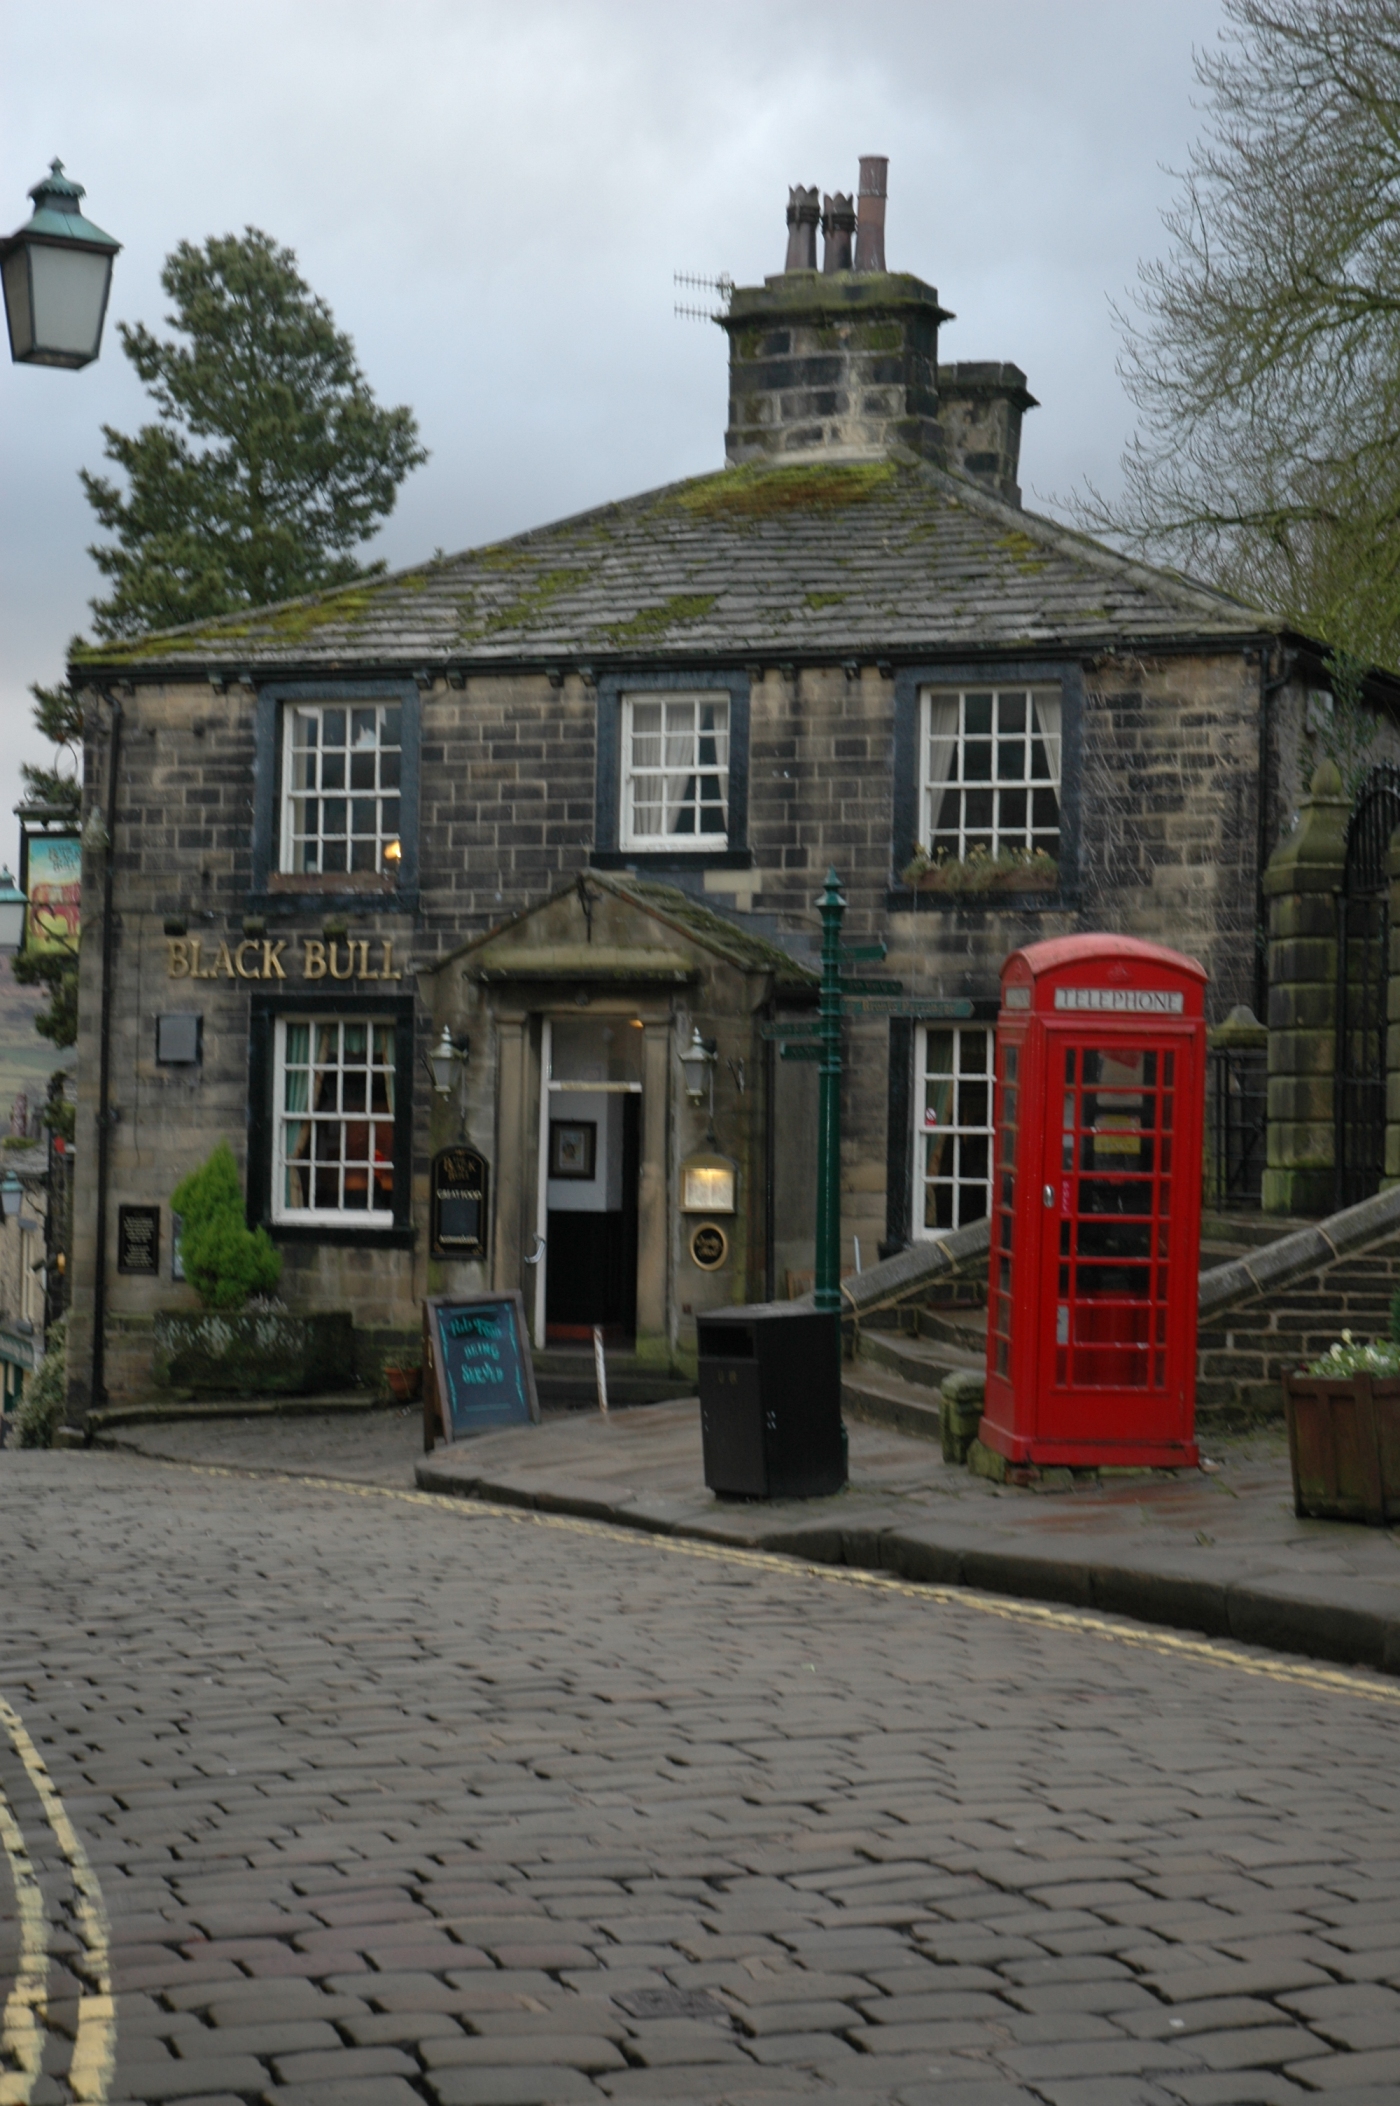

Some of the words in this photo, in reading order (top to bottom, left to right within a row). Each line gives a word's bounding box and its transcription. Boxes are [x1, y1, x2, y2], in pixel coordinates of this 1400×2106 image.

[167, 938, 287, 980] BLACK
[303, 939, 402, 981] BULL
[1062, 988, 1179, 1012] TELEPHONE
